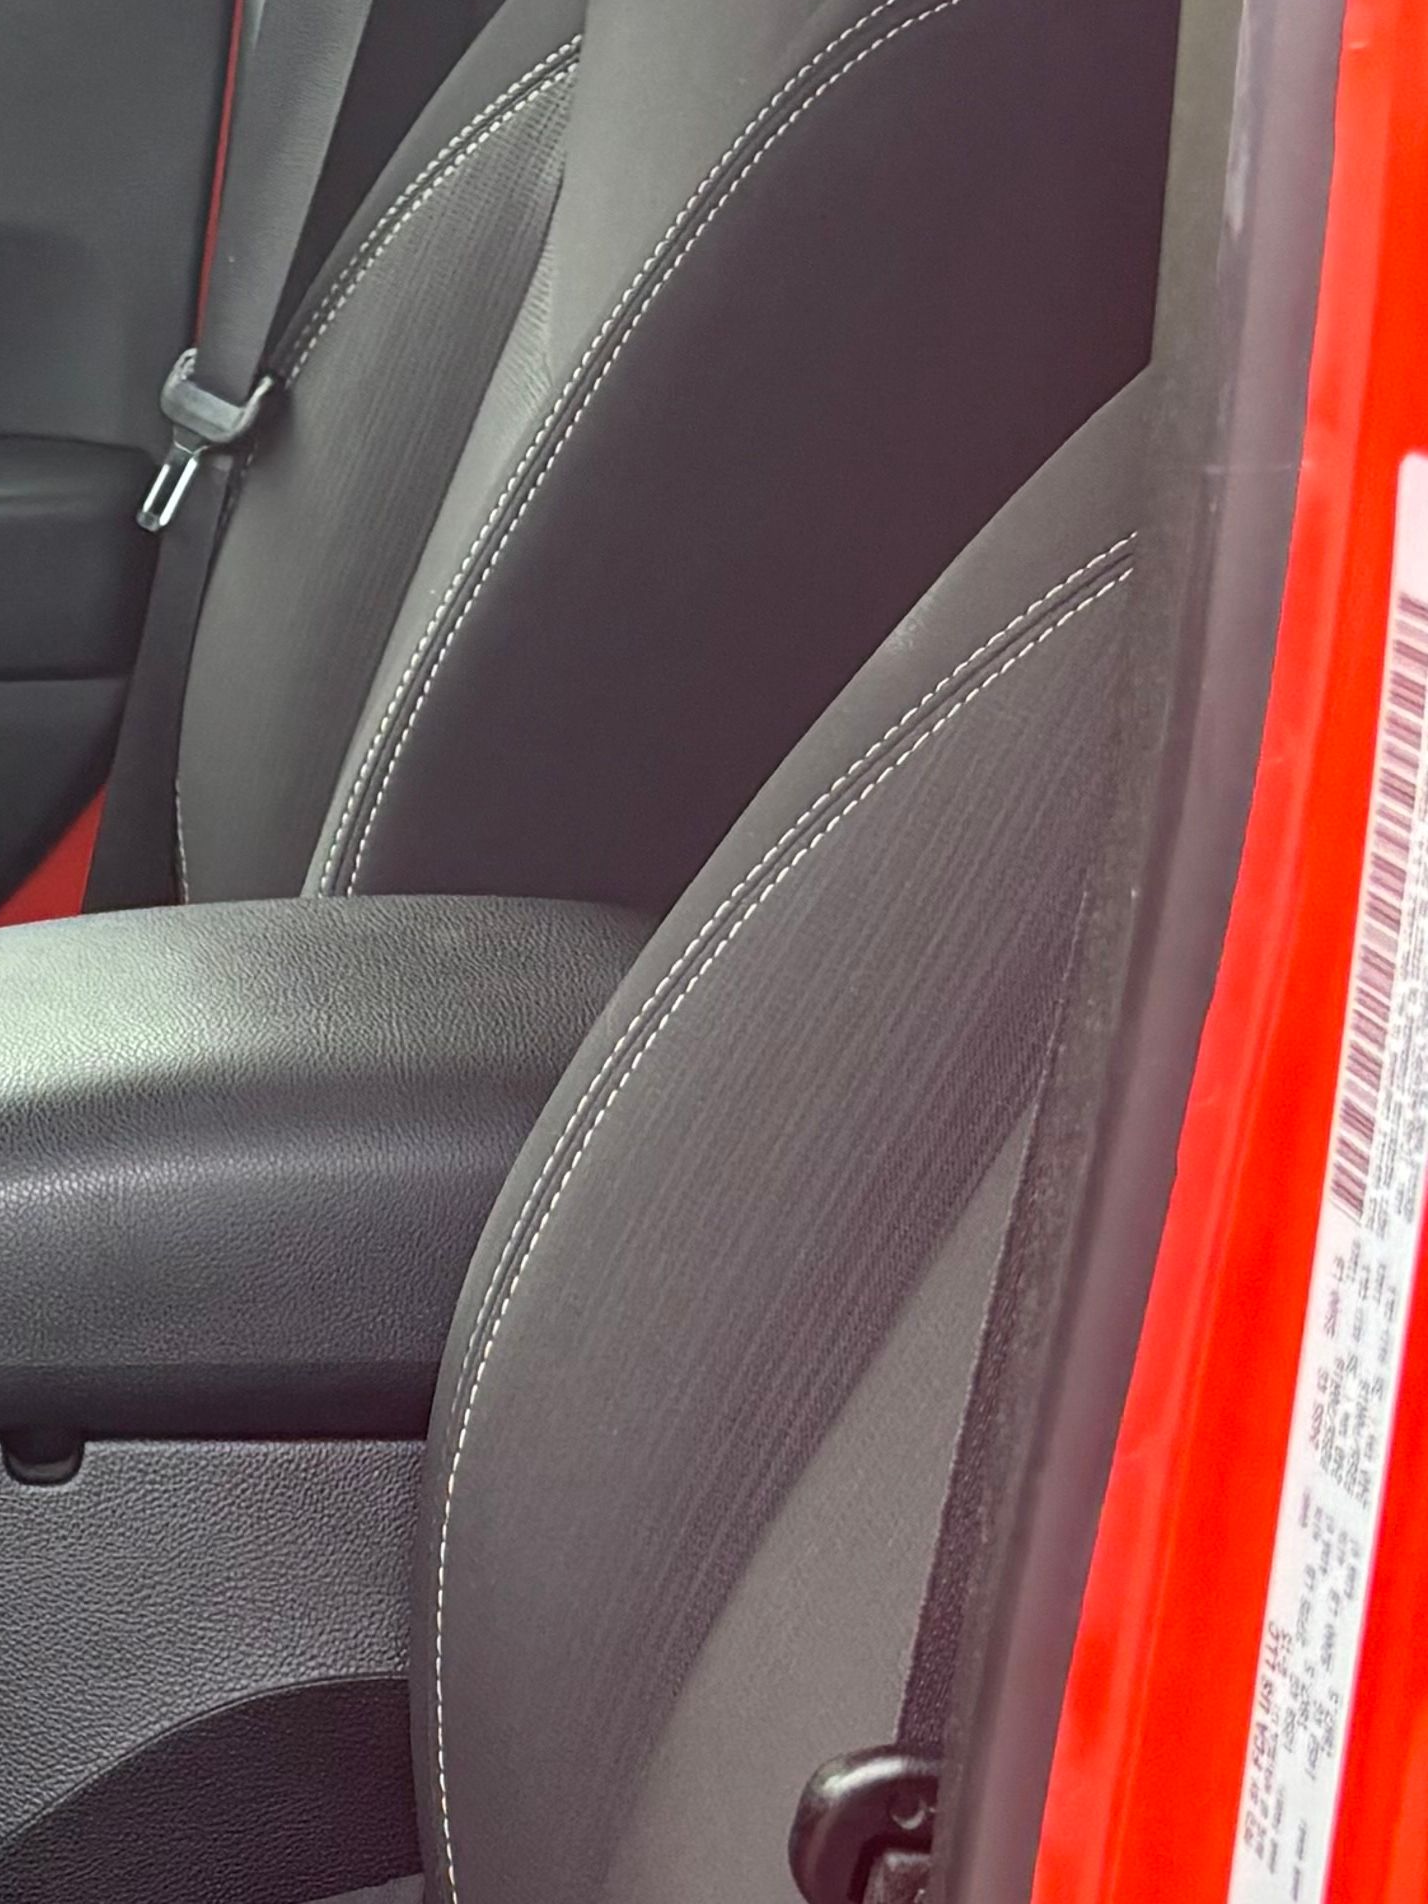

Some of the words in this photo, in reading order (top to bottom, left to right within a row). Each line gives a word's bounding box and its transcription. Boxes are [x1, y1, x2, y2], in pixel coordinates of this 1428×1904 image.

[1265, 1619, 1279, 1674] LLC
[1260, 1677, 1272, 1715] US
[1253, 1721, 1267, 1772] FCA
